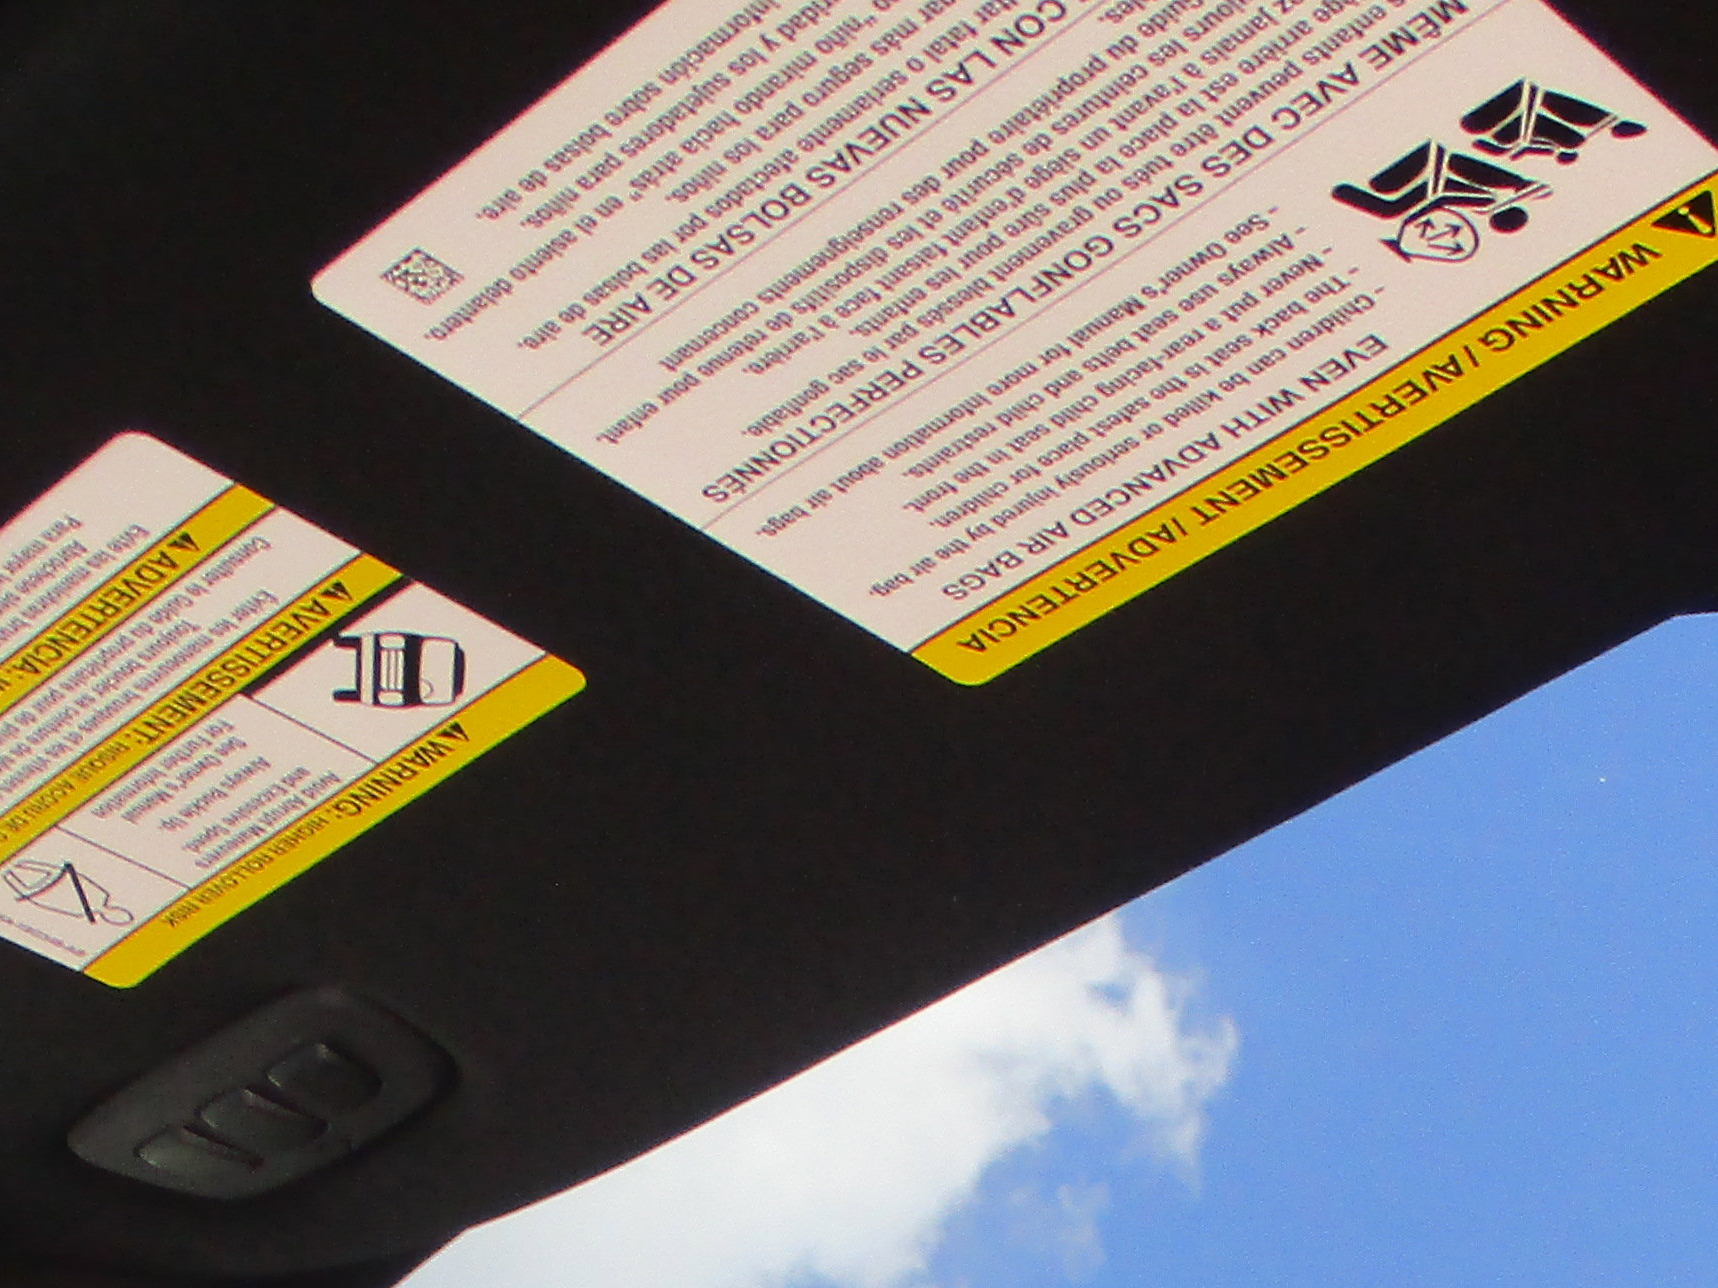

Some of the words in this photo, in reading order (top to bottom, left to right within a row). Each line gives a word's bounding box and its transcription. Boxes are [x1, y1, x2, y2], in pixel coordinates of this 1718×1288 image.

[868, 18, 922, 58] más
[920, 20, 981, 66] fatal
[988, 0, 1069, 58] CON
[1198, 5, 1282, 67] jamais
[1299, 4, 1389, 67] enfants
[1356, 0, 1471, 72] MÊME
[1145, 38, 1191, 69] les
[732, 50, 820, 116] mirando
[800, 52, 875, 109] seguro
[923, 49, 999, 104] LAS
[1212, 59, 1306, 130] peuvent
[1269, 61, 1362, 132] AVEC
[752, 100, 807, 143] para
[795, 69, 911, 154] seriamente
[1049, 63, 1151, 137] ceintures
[1106, 74, 1190, 133] l'avant
[678, 110, 744, 156] hacia
[721, 138, 764, 166] los
[804, 96, 934, 190] NUEVAS
[1020, 132, 1055, 158] de
[1077, 126, 1114, 153] un
[1168, 122, 1221, 159] être
[1199, 124, 1276, 180] DES
[663, 160, 729, 204] niños.
[702, 148, 801, 220] afectados
[939, 152, 1027, 216] sécurité
[1022, 147, 1083, 191] siège
[1119, 154, 1176, 192] tués
[592, 195, 626, 220] en
[914, 208, 945, 232] et
[939, 186, 1028, 249] d'enfant
[1090, 186, 1125, 213] ou
[1110, 173, 1205, 240] SACS
[572, 214, 600, 238] el
[671, 212, 711, 245] por
[688, 182, 814, 272] BOLSAS
[884, 224, 927, 252] les
[986, 204, 1096, 284] gravement
[1222, 213, 1272, 246] See
[507, 229, 580, 283] asiento
[639, 238, 681, 266] las
[873, 241, 951, 293] faisant
[1139, 241, 1230, 301] Owner's
[1215, 232, 1296, 288] Always
[581, 260, 651, 308] bolsas
[645, 264, 699, 302] DE
[788, 246, 891, 316] dispositifs
[1258, 253, 1326, 299] Never
[1302, 275, 1353, 305] The
[422, 277, 515, 342] delantero.
[556, 302, 588, 325] de
[832, 286, 884, 320] face
[914, 276, 997, 330] blessés
[916, 234, 1116, 366] GONFLABLES
[1176, 283, 1221, 314] use
[1218, 290, 1262, 324] put
[1476, 242, 1664, 354] WARNING
[516, 320, 564, 351] aire.
[580, 292, 654, 348] AIRE
[763, 311, 795, 333] de
[882, 321, 922, 352] par
[1065, 296, 1149, 351] Manual
[1129, 309, 1181, 345] seat
[1248, 300, 1311, 340] back
[1284, 293, 1378, 352] Children
[695, 328, 771, 379] retenue
[740, 324, 827, 376] l'arrière.
[860, 346, 891, 364] le
[1036, 342, 1074, 368] for
[1080, 337, 1140, 374] belts
[1093, 328, 1207, 399] rear-facing
[1182, 362, 1212, 381] is
[1202, 333, 1255, 369] seat
[1244, 347, 1289, 377] can
[1297, 333, 1390, 394] EVEN
[656, 371, 703, 407] pour
[826, 358, 867, 386] sac
[984, 361, 1042, 398] more
[1041, 368, 1085, 401] and
[1147, 375, 1190, 402] the
[1216, 371, 1253, 394] be
[594, 401, 661, 446] enfant.
[740, 378, 832, 438] gonflable.
[881, 392, 994, 461] information
[993, 392, 1047, 429] child
[1047, 394, 1101, 431] child
[1086, 396, 1153, 439] safest
[1160, 389, 1225, 430] killed
[1218, 387, 1306, 440] WITH
[700, 358, 926, 504] PERFECTIONNÉS
[900, 421, 1000, 479] restraints.
[1004, 423, 1053, 455] seat
[1035, 430, 1093, 469] place
[1139, 422, 1166, 442] or
[828, 455, 886, 495] about
[951, 460, 992, 485] the
[983, 448, 1014, 466] in
[1007, 463, 1044, 487] for
[1053, 436, 1142, 491] seriously
[804, 488, 835, 511] air
[901, 480, 960, 514] front.
[1068, 431, 1223, 528] ADVANCED
[754, 505, 812, 538] bags.
[927, 481, 1011, 529] children.
[988, 485, 1062, 530] injured
[933, 537, 973, 561] the
[963, 522, 998, 543] by
[1015, 520, 1071, 556] AIR
[867, 572, 916, 598] bag.
[908, 556, 939, 578] air
[940, 549, 1026, 602] BAGS
[4, 549, 181, 681] ADVERTENCIA:
[123, 597, 333, 746] AVERTISSEMENT:
[324, 739, 456, 820] WARNING:
